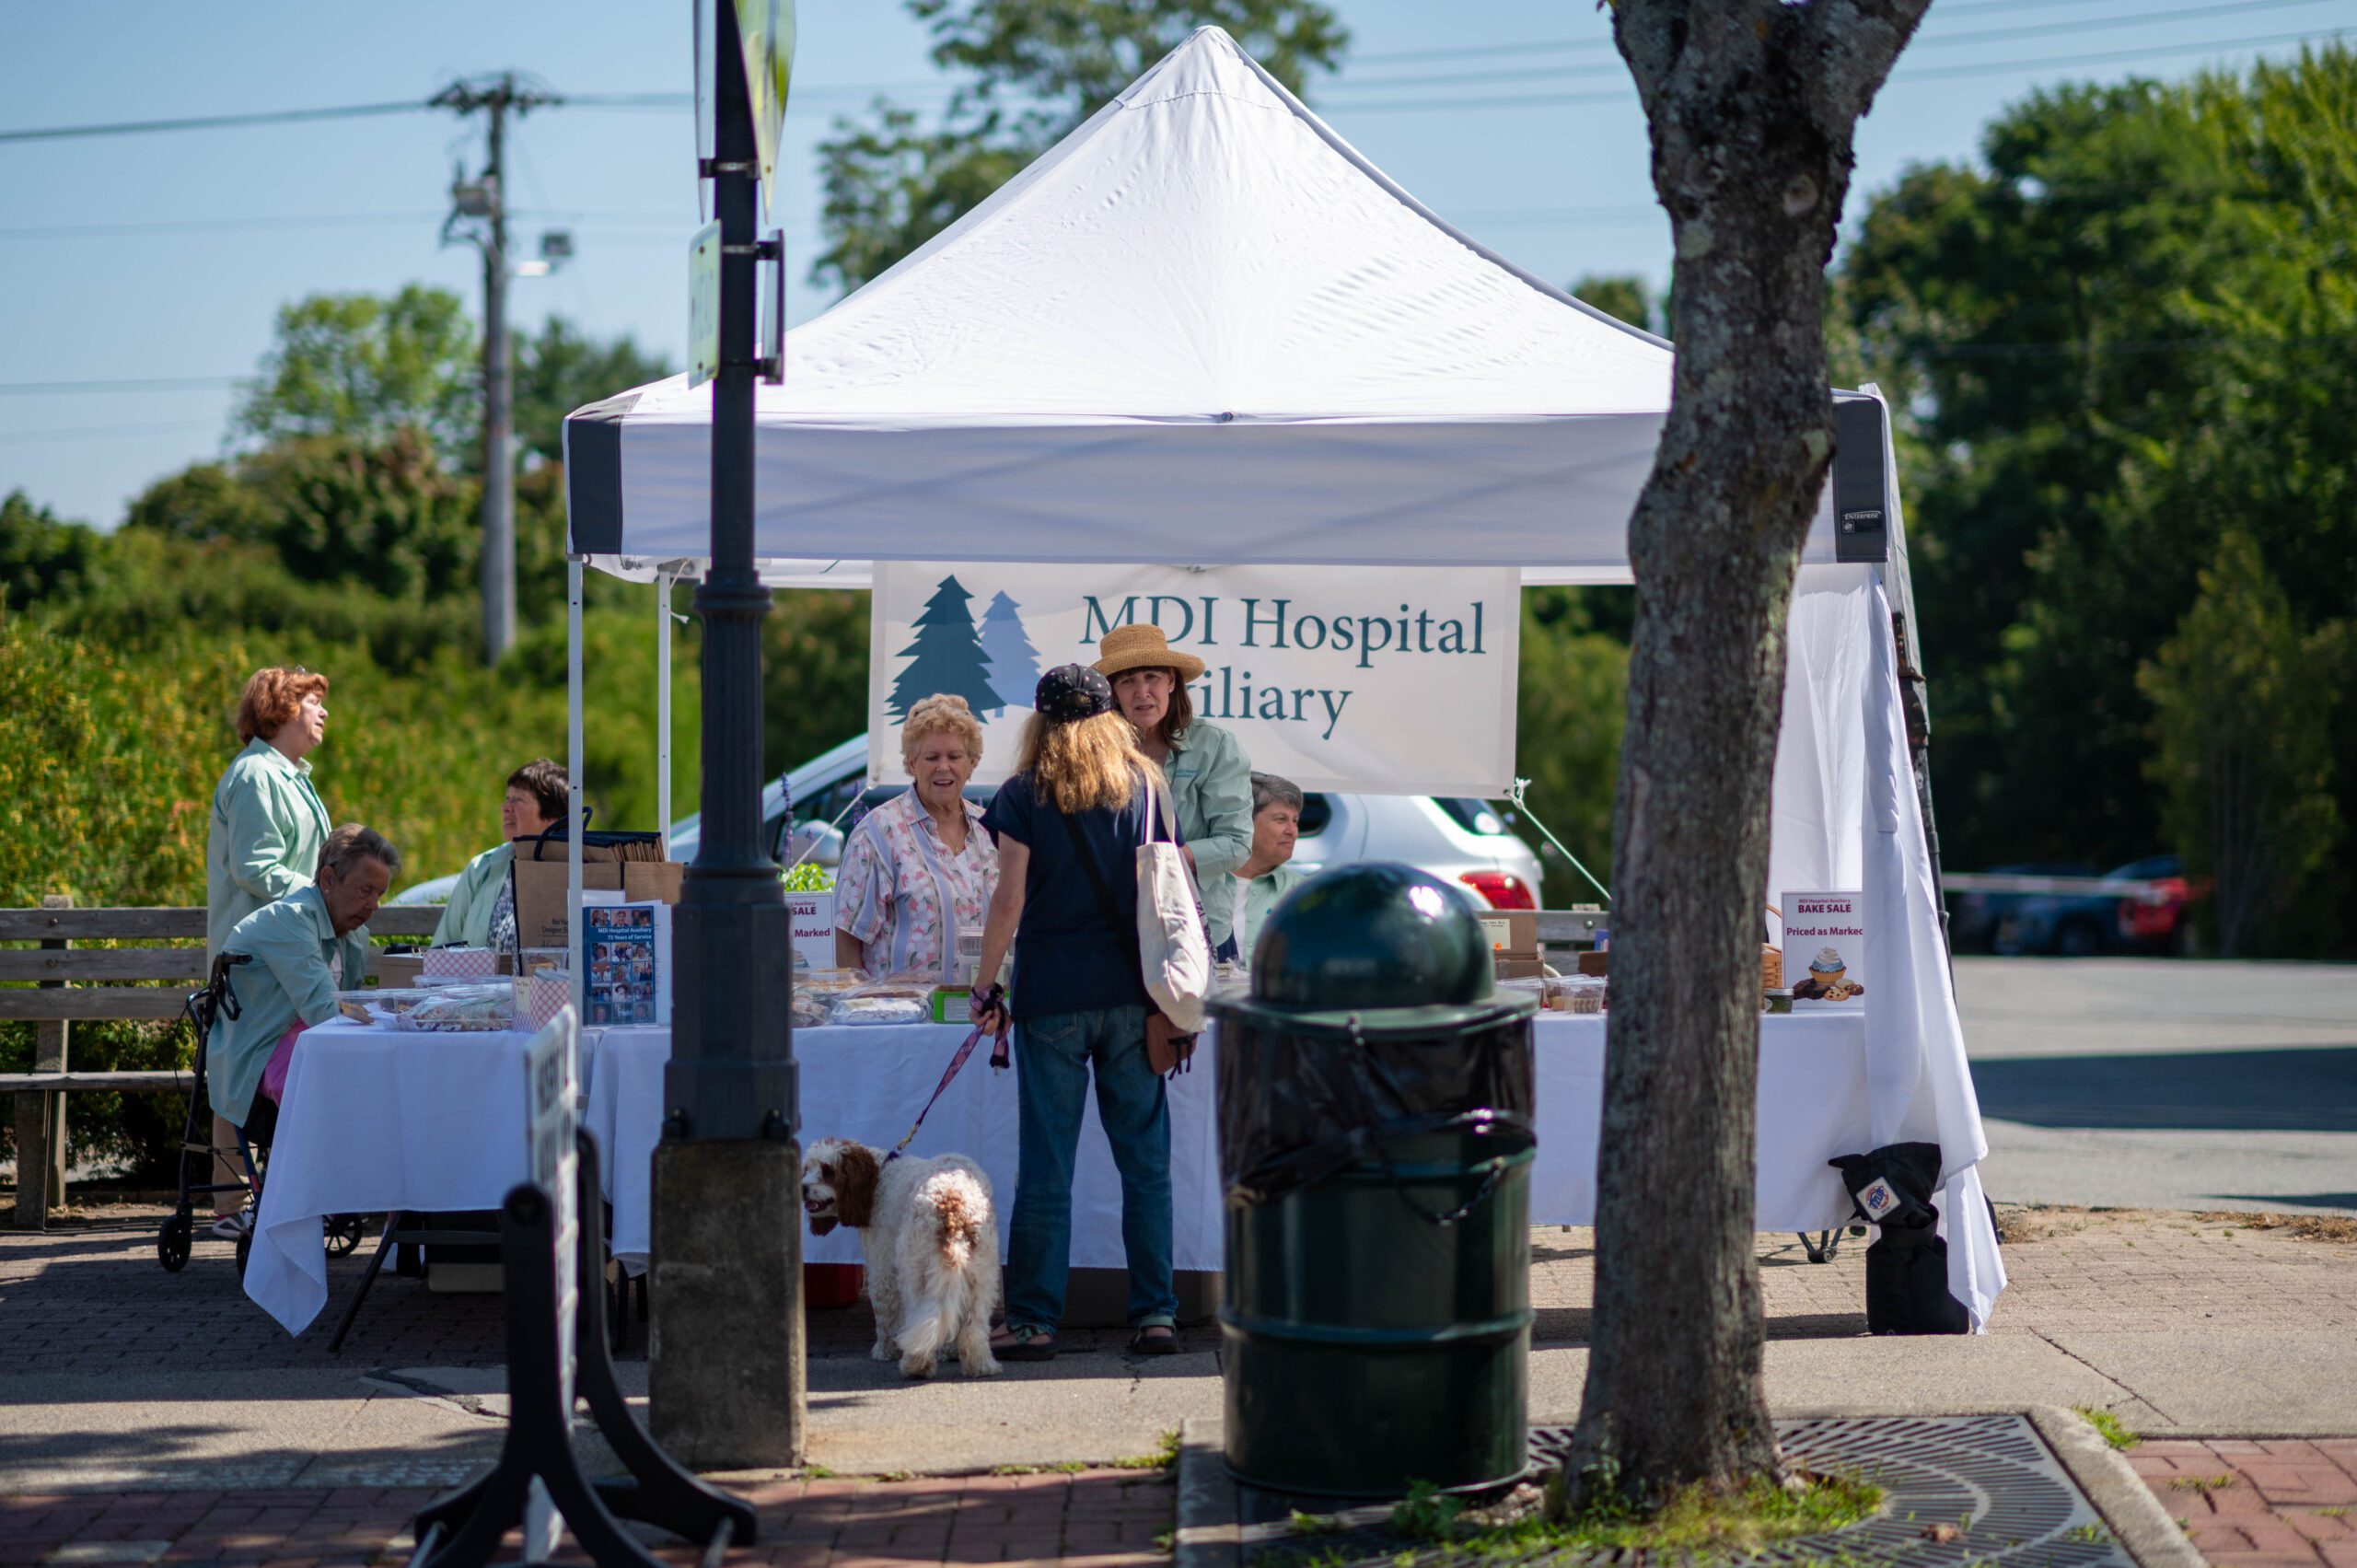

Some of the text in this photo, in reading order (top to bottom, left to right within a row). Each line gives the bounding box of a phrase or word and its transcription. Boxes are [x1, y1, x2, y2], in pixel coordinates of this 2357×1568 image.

[1079, 596, 1487, 668] MDI Hospital
[1186, 666, 1353, 740] iliary
[792, 907, 817, 915] SALE
[1798, 904, 1852, 913] BAKE SALE
[795, 928, 830, 937] Marked
[1786, 926, 1816, 935] Priced
